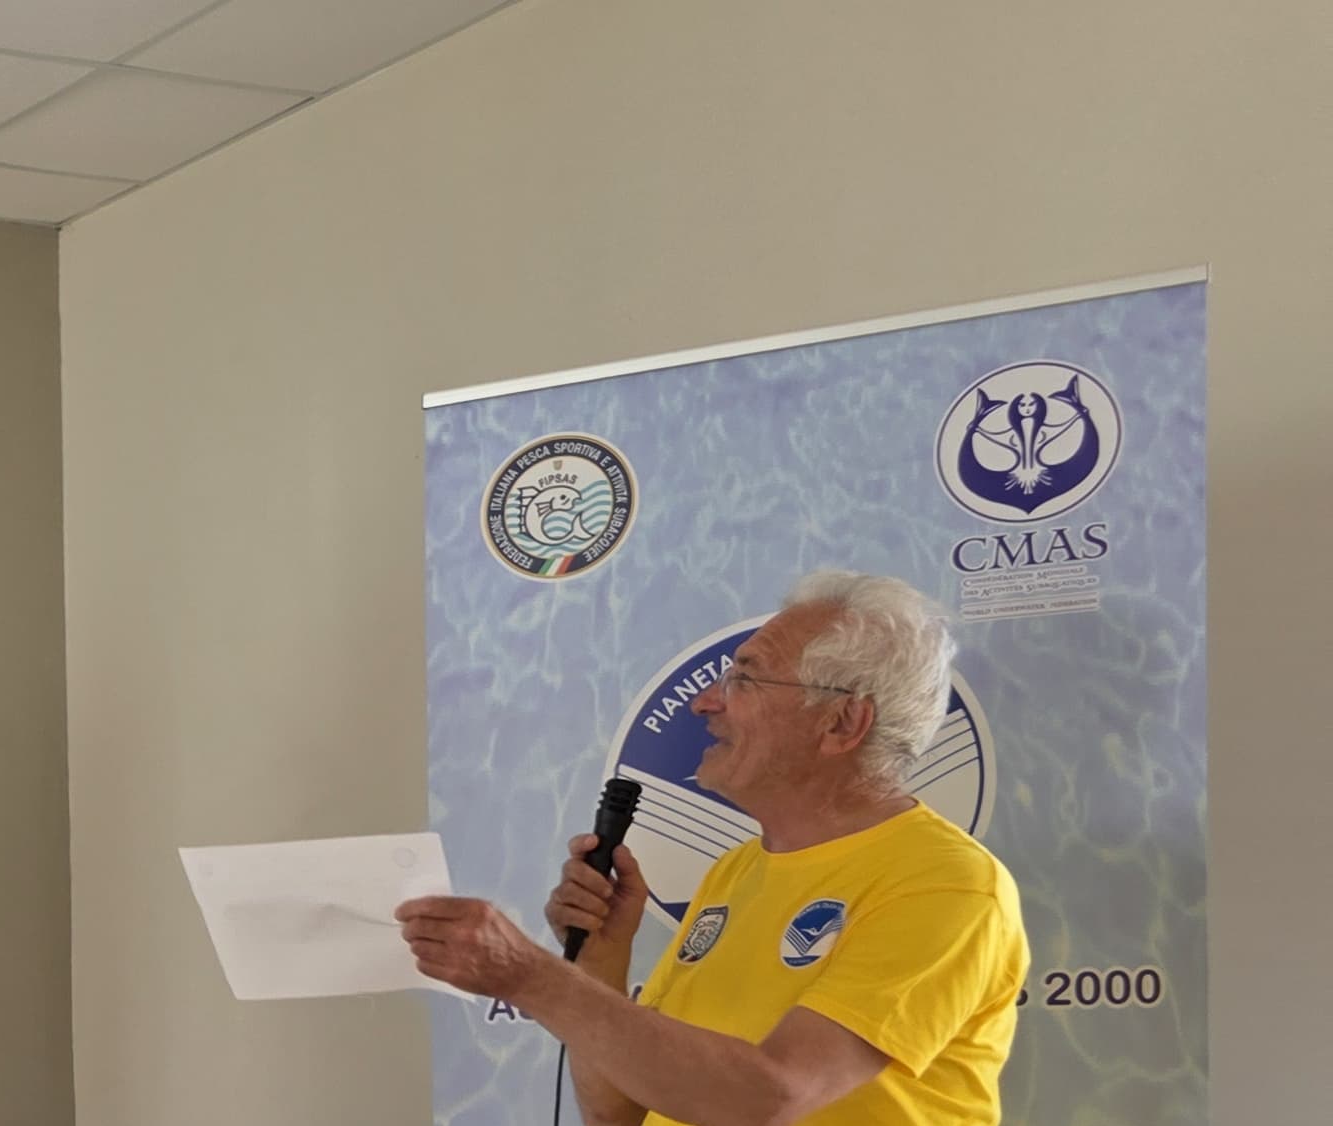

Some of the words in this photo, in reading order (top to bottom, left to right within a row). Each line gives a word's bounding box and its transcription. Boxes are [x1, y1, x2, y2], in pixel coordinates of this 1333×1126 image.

[518, 445, 550, 469] PESCA
[554, 442, 601, 461] SPORTIVA
[600, 456, 611, 467] E
[490, 467, 519, 512] ITALIANA
[538, 473, 578, 488] FIPSAS
[490, 514, 534, 569] FEDERAZIONE
[585, 508, 626, 562] SUBACQUEE
[952, 523, 1108, 572] CMAS
[643, 654, 734, 733] PIANETA
[1045, 969, 1161, 1006] 2000
